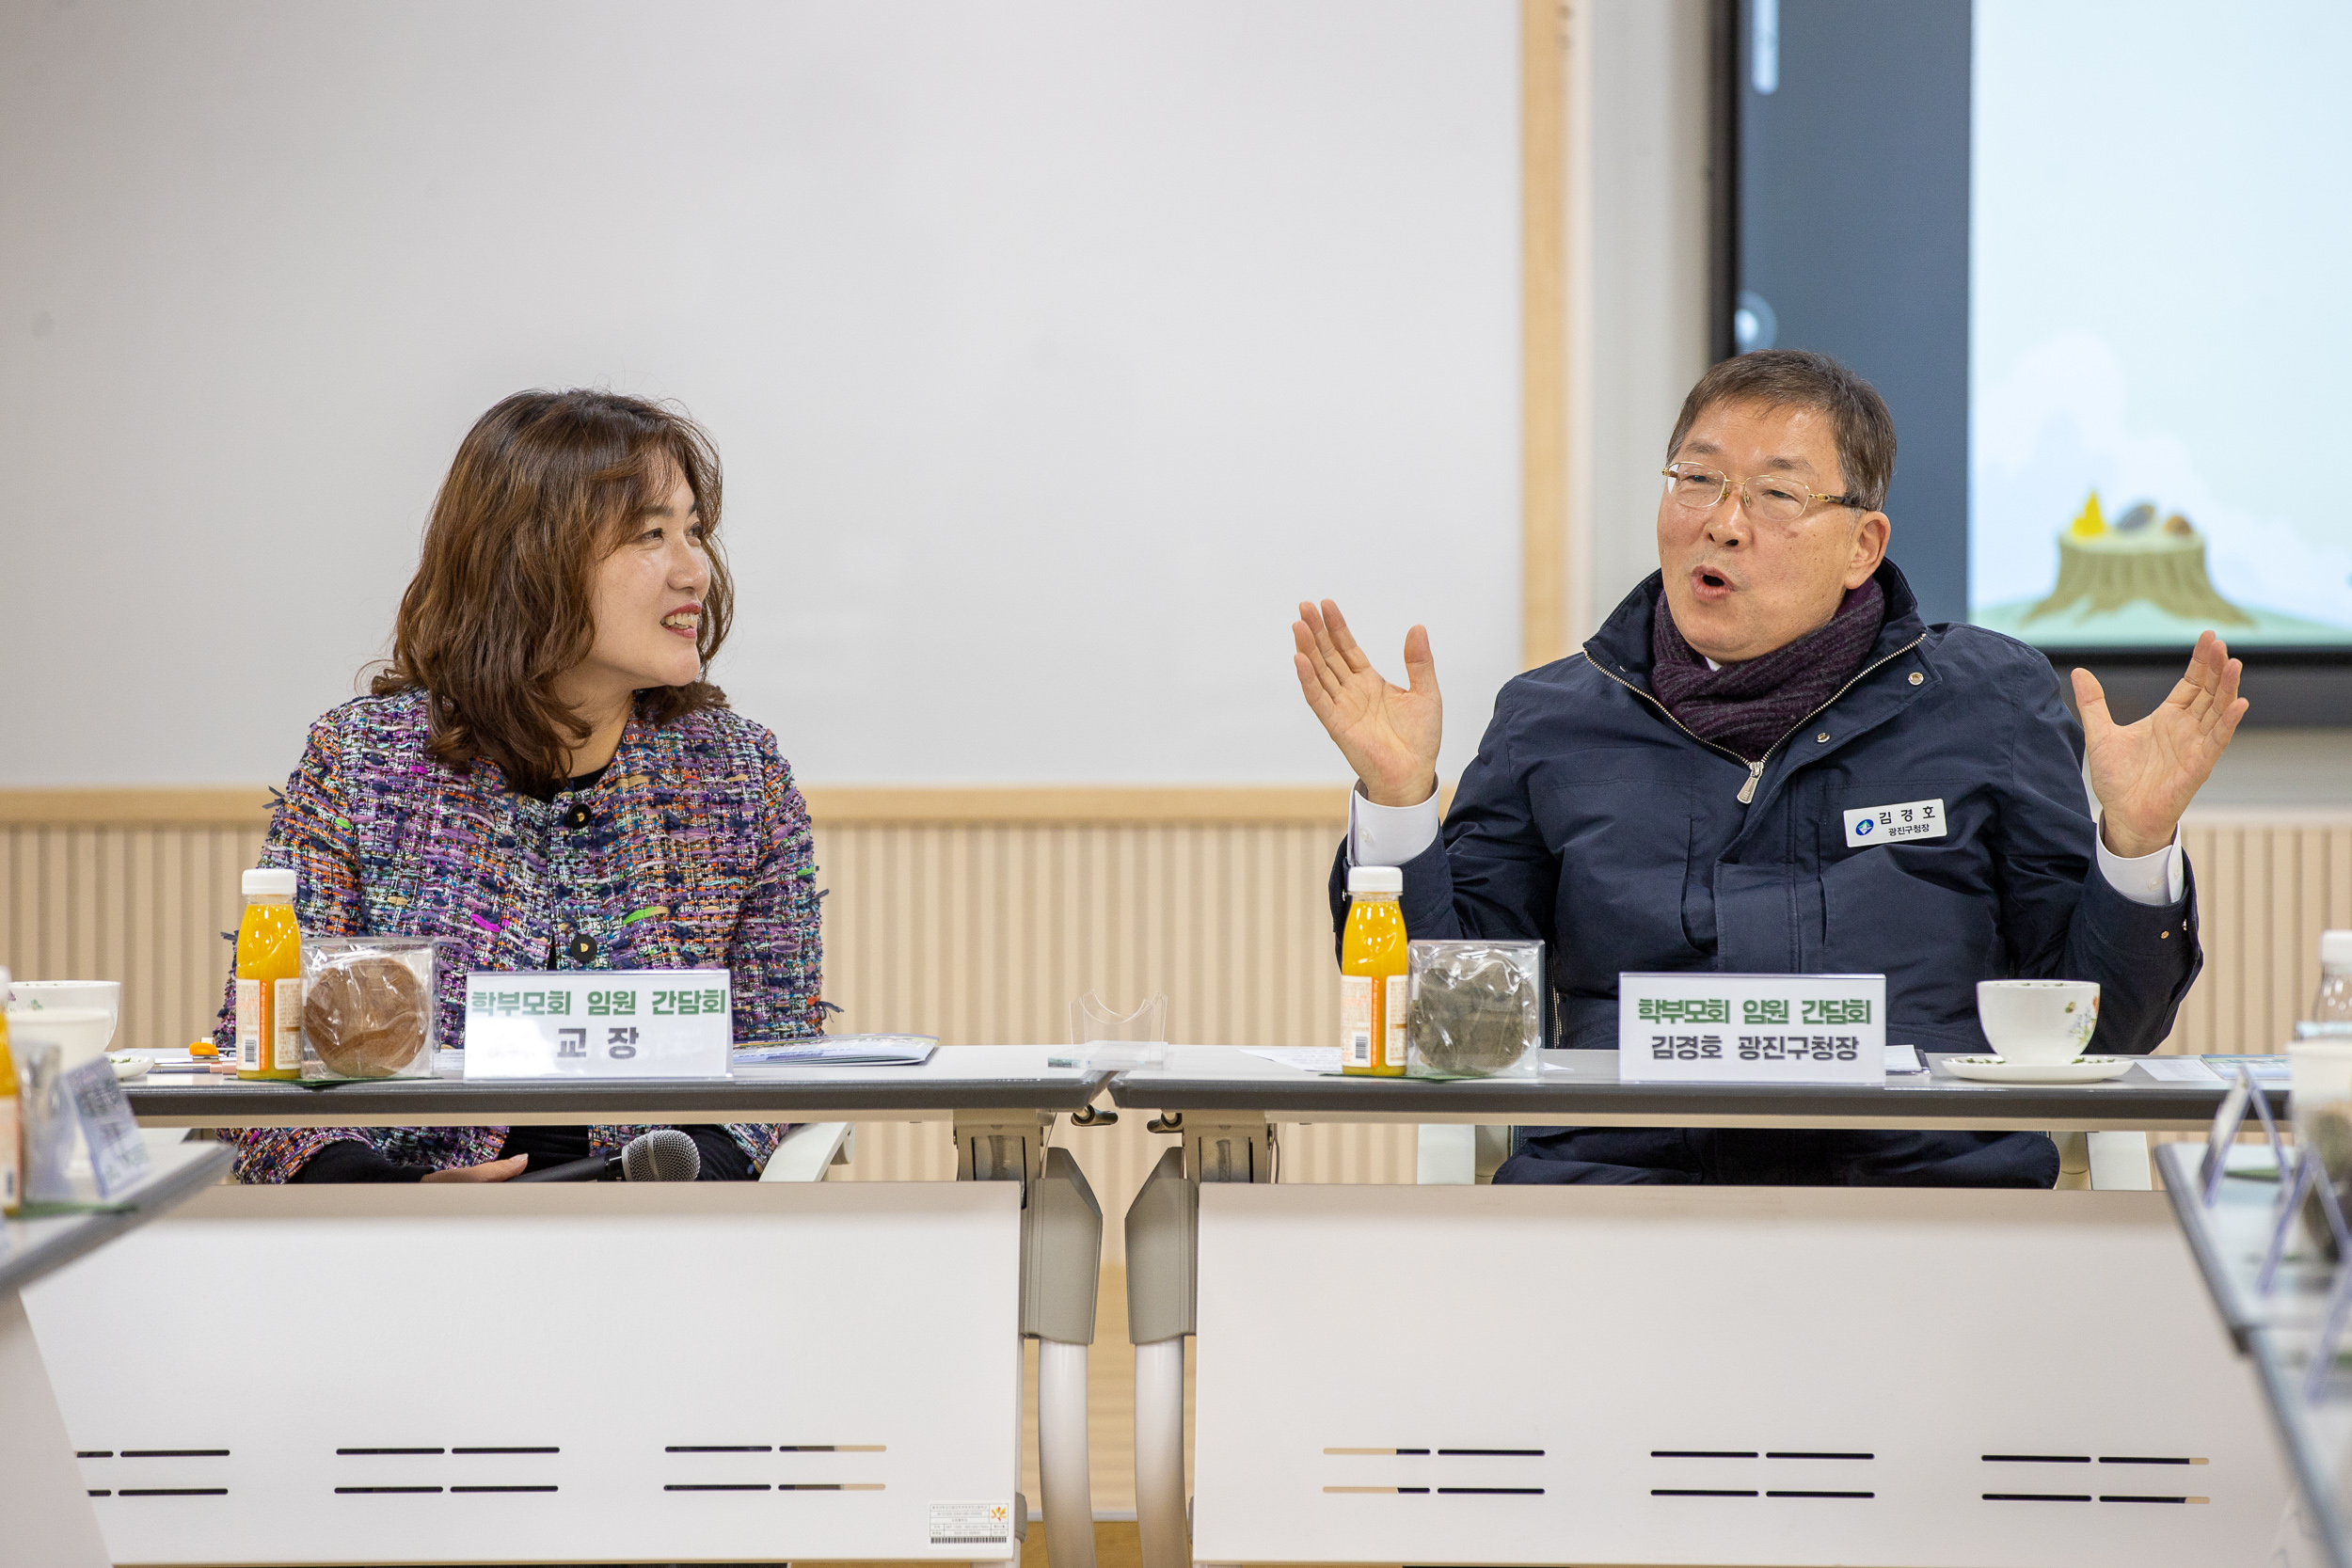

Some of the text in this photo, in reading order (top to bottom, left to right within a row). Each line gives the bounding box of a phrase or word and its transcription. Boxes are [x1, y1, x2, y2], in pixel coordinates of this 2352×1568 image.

[1888, 823, 1930, 836] 광진구청장
[471, 990, 726, 1017] 학부모회 임원 간담회
[1638, 998, 1871, 1024] 학부모회 임원 간담회
[1651, 1035, 1859, 1061] 김경호 광진구청장
